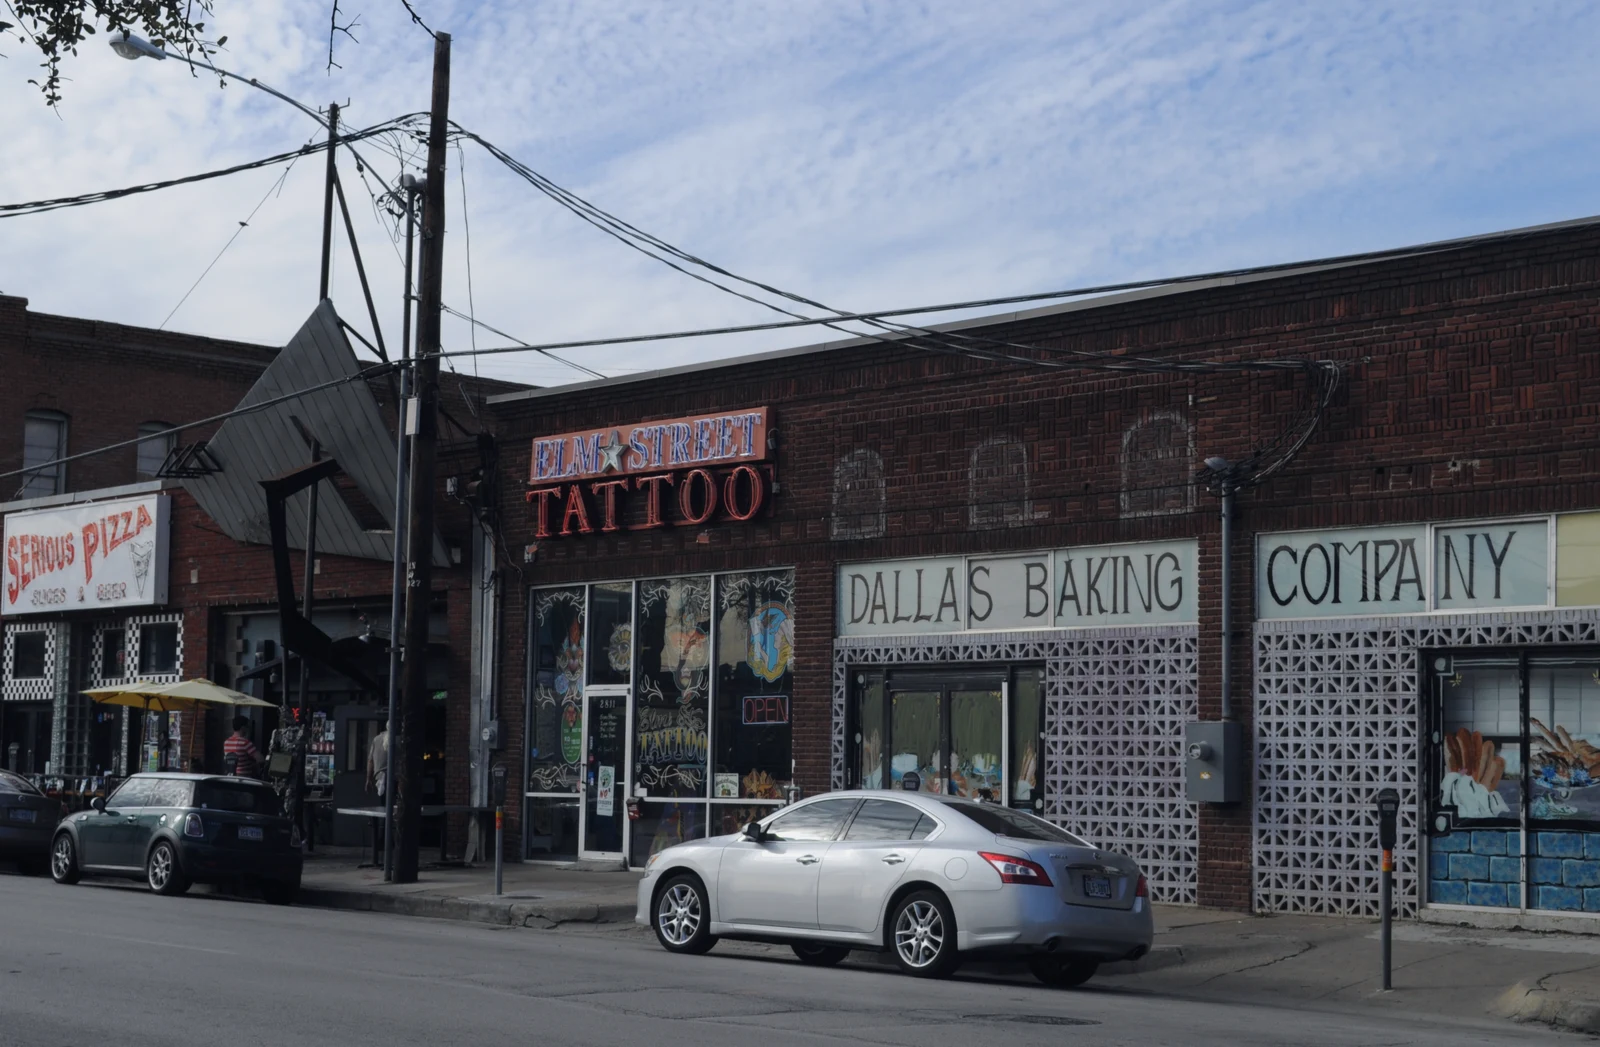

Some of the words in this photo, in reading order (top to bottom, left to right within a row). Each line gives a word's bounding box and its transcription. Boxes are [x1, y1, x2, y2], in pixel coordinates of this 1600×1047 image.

[532, 433, 605, 480] ELM
[627, 412, 762, 469] STREET
[525, 465, 764, 539] TATTOO
[7, 532, 75, 605] SERIOUS
[82, 504, 153, 585] PIZZA
[847, 566, 993, 625] DALLAS
[1023, 551, 1184, 619] BAKING
[1267, 530, 1517, 606] COMPANY
[31, 587, 67, 605] SLICES
[77, 586, 85, 602] &
[97, 582, 127, 601] BEER
[599, 699, 616, 709] 2811
[744, 698, 789, 723] OPEN
[637, 727, 708, 764] TATTOO
